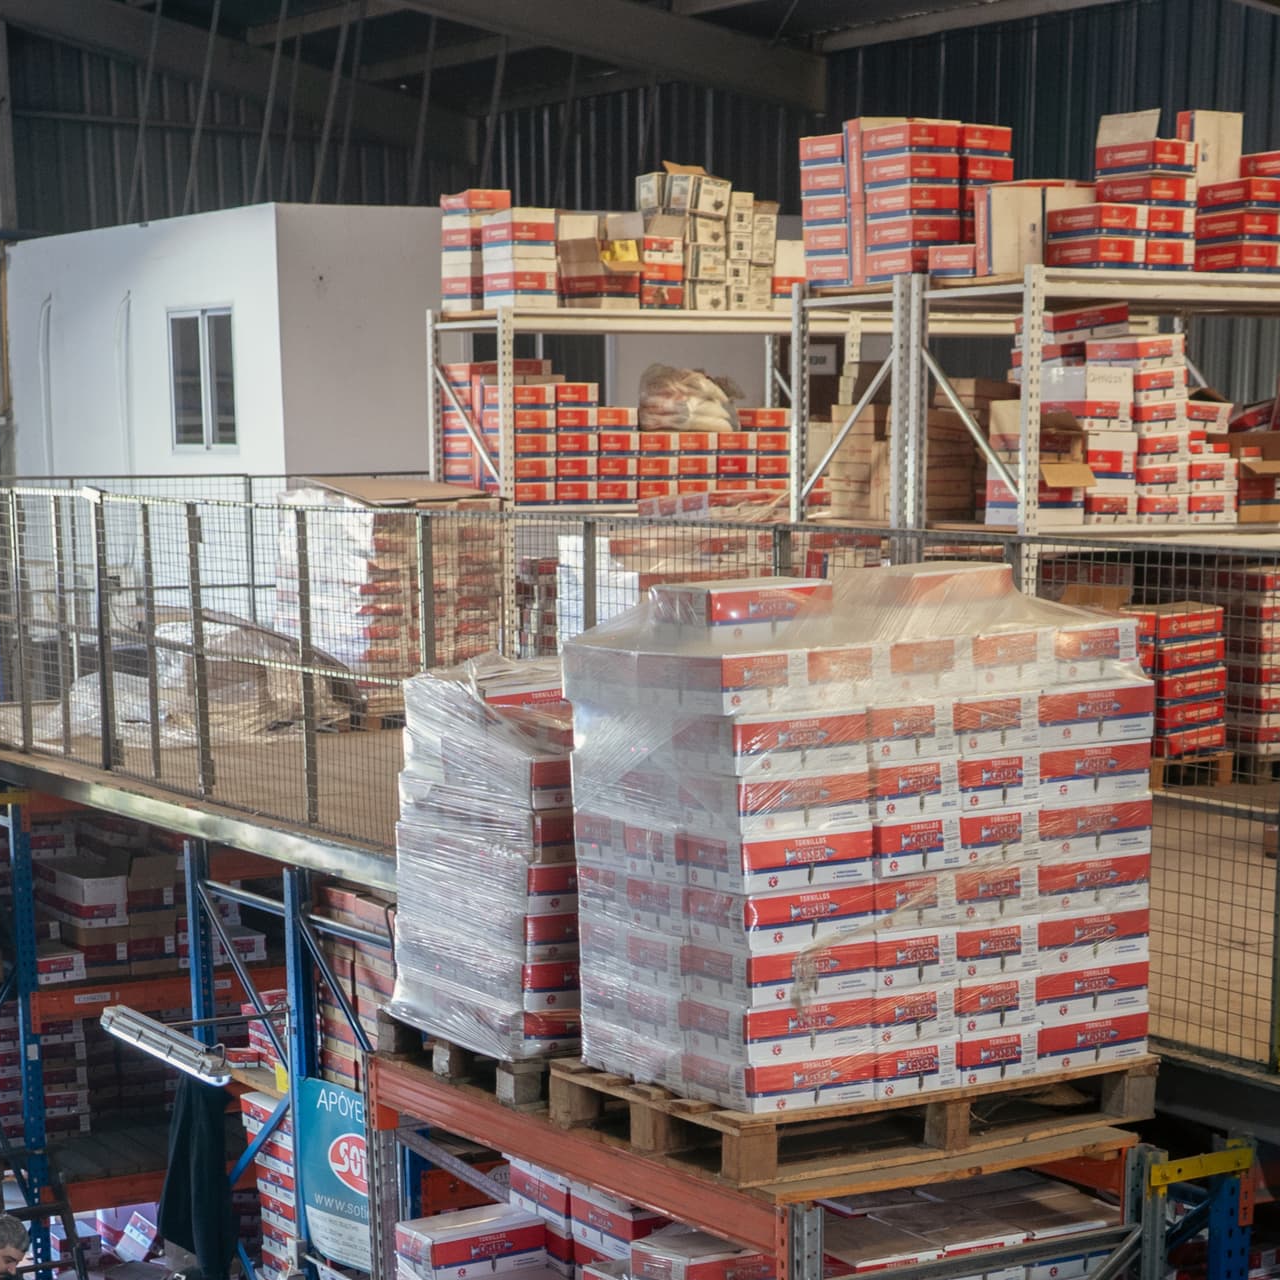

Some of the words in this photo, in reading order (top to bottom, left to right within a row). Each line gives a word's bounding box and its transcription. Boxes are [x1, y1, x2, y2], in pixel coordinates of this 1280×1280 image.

[991, 757, 1020, 768] TORNILLOS
[989, 767, 1018, 782] CASER
[990, 815, 1019, 824] TORNILLOS
[910, 821, 939, 831] TORNILLOS
[795, 837, 827, 847] TORNILLOS
[909, 830, 938, 848] CASER
[796, 846, 828, 862] CASER
[799, 893, 831, 903] TORNILLOS
[800, 902, 831, 919] CASER
[989, 927, 1018, 937] TORNILLOS
[906, 937, 936, 947] TORNILLOS
[906, 946, 935, 965] CASER
[989, 1036, 1018, 1046] TORNILLOS
[905, 1047, 935, 1057] TORNILLOS
[989, 1046, 1018, 1062] CASER
[906, 1056, 935, 1072] CASER
[478, 1233, 507, 1243] TORNILLOS
